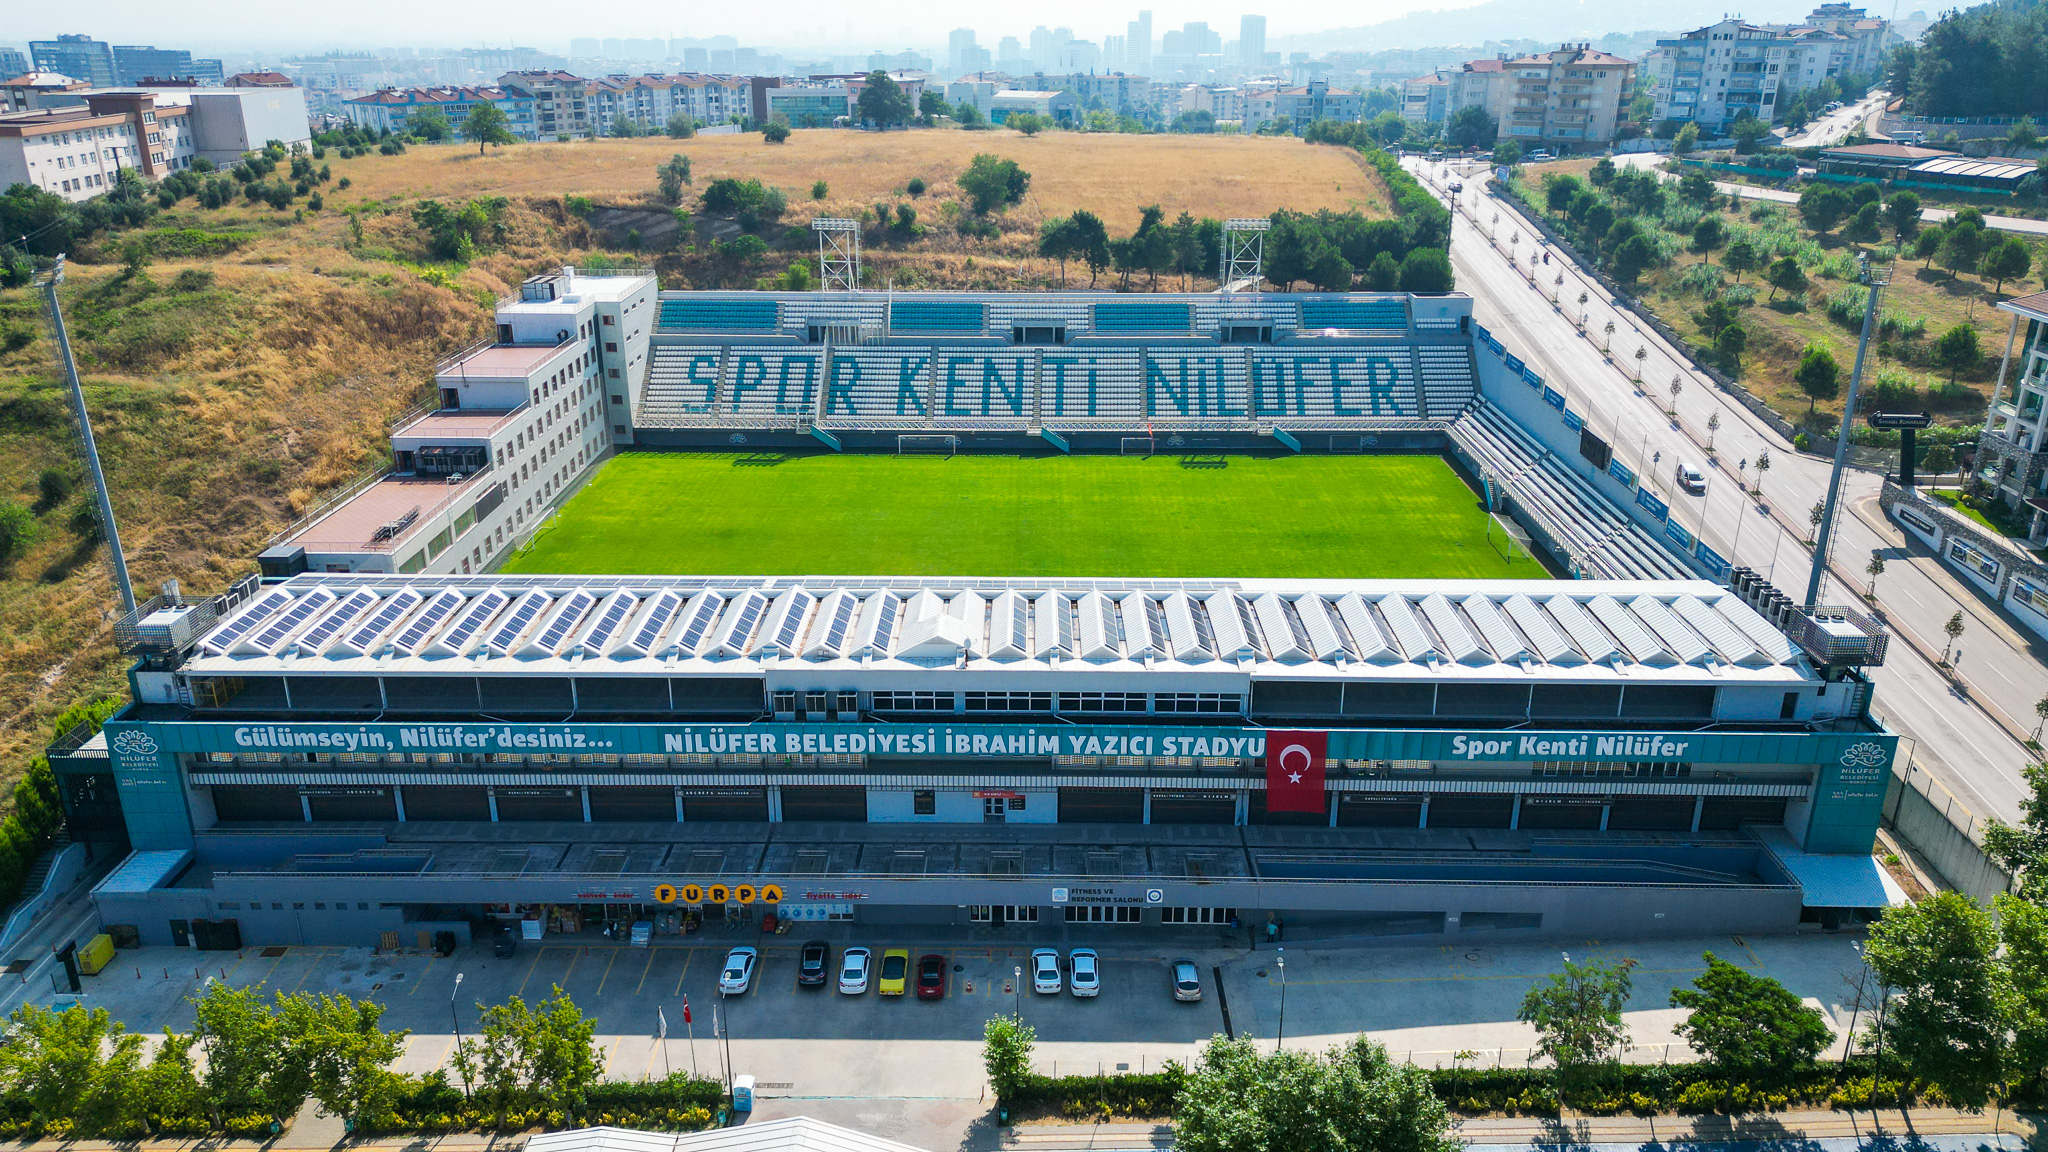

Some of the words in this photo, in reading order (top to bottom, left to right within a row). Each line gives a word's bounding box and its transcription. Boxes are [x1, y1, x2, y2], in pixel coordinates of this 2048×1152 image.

[681, 356, 863, 415] SPOR
[1147, 358, 1404, 416] NİLÜFER
[235, 727, 394, 751] Gülümseyin,
[665, 728, 776, 752] NİLÜFER
[786, 728, 935, 753] BELEDİYESİ
[945, 728, 1059, 754] İBRAHİM
[1069, 735, 1153, 755] YAZICI
[1452, 736, 1512, 759] Spor
[1519, 736, 1588, 755] Kenti
[1596, 736, 1689, 756] Nilüfer
[660, 888, 780, 901] FURPA
[1071, 887, 1101, 895] FİTNESS
